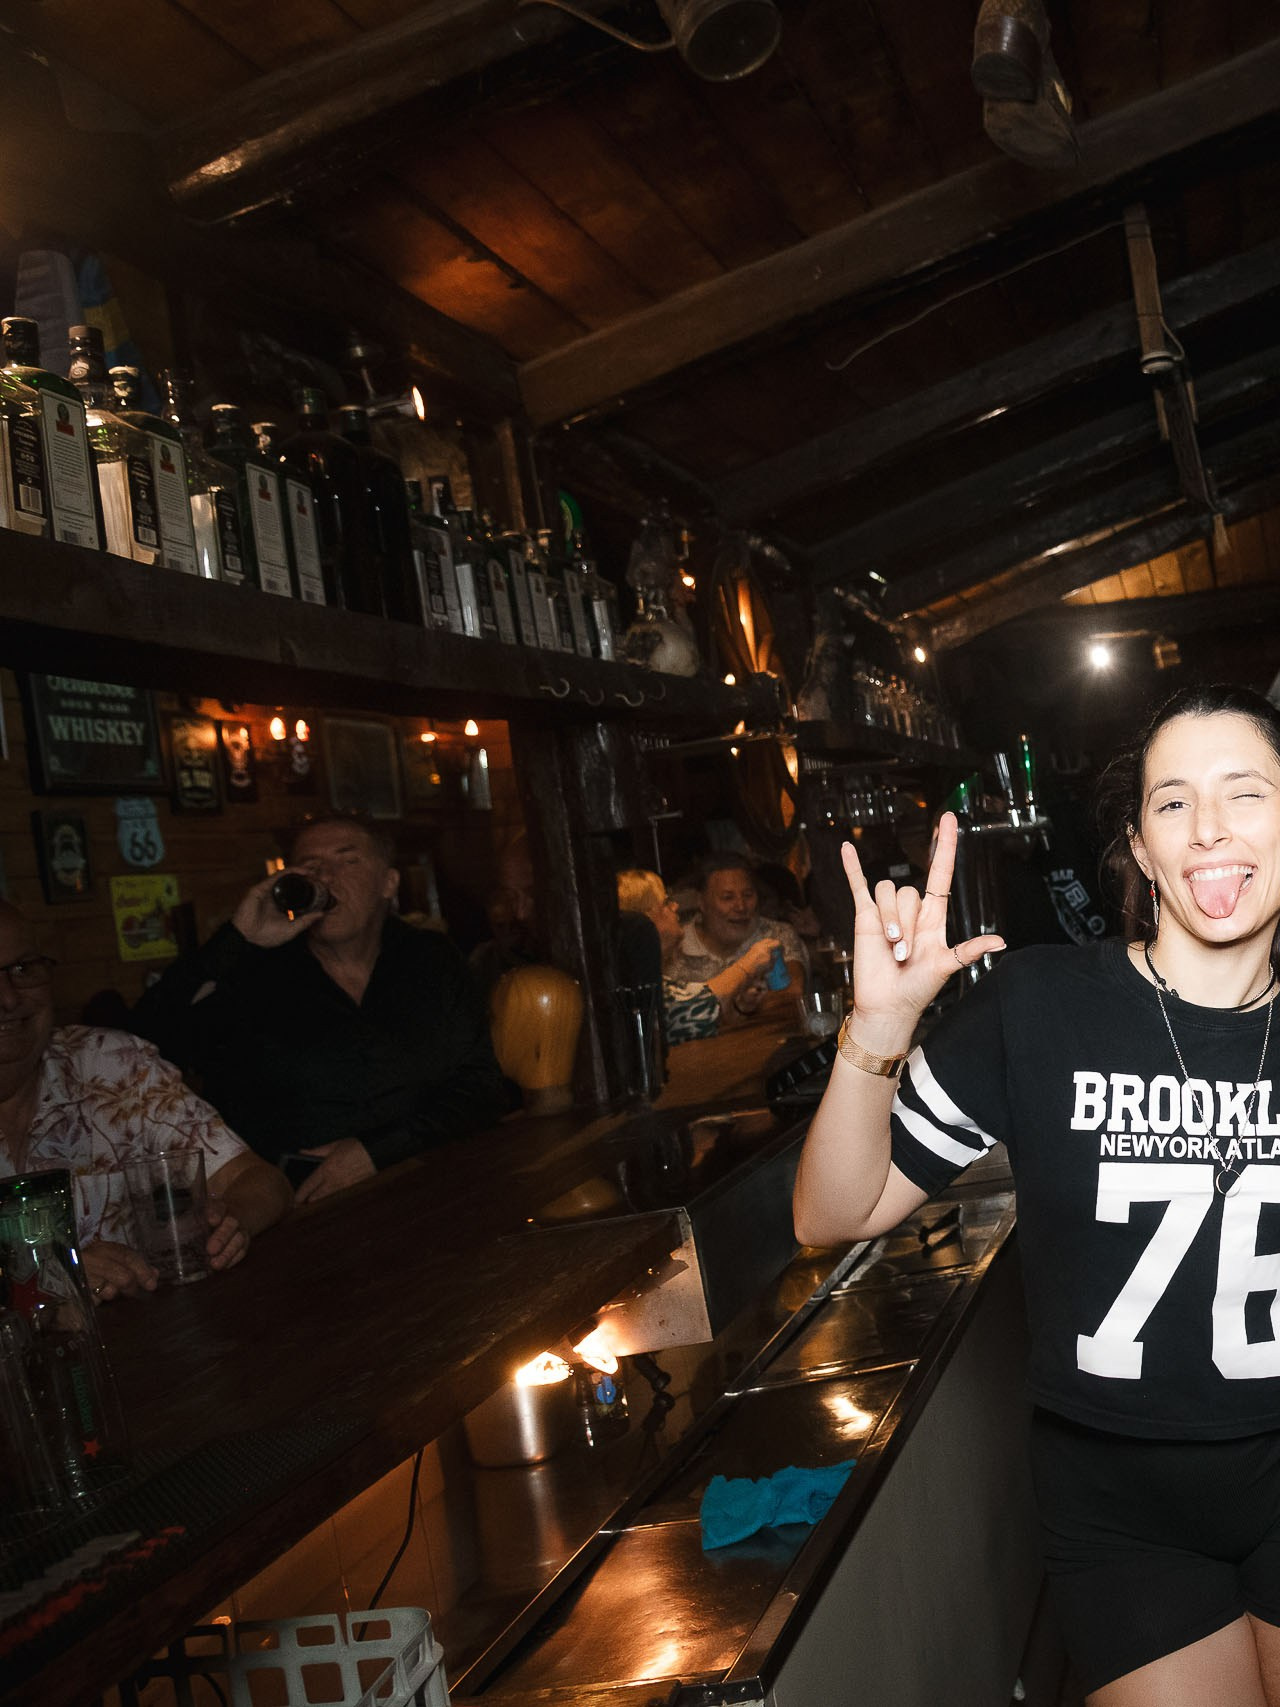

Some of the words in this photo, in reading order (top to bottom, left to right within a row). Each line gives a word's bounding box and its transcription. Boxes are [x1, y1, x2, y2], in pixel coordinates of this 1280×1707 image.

[47, 714, 146, 747] WHISKEY
[129, 832, 158, 862] 66
[1100, 1133, 1220, 1160] NEWYORK
